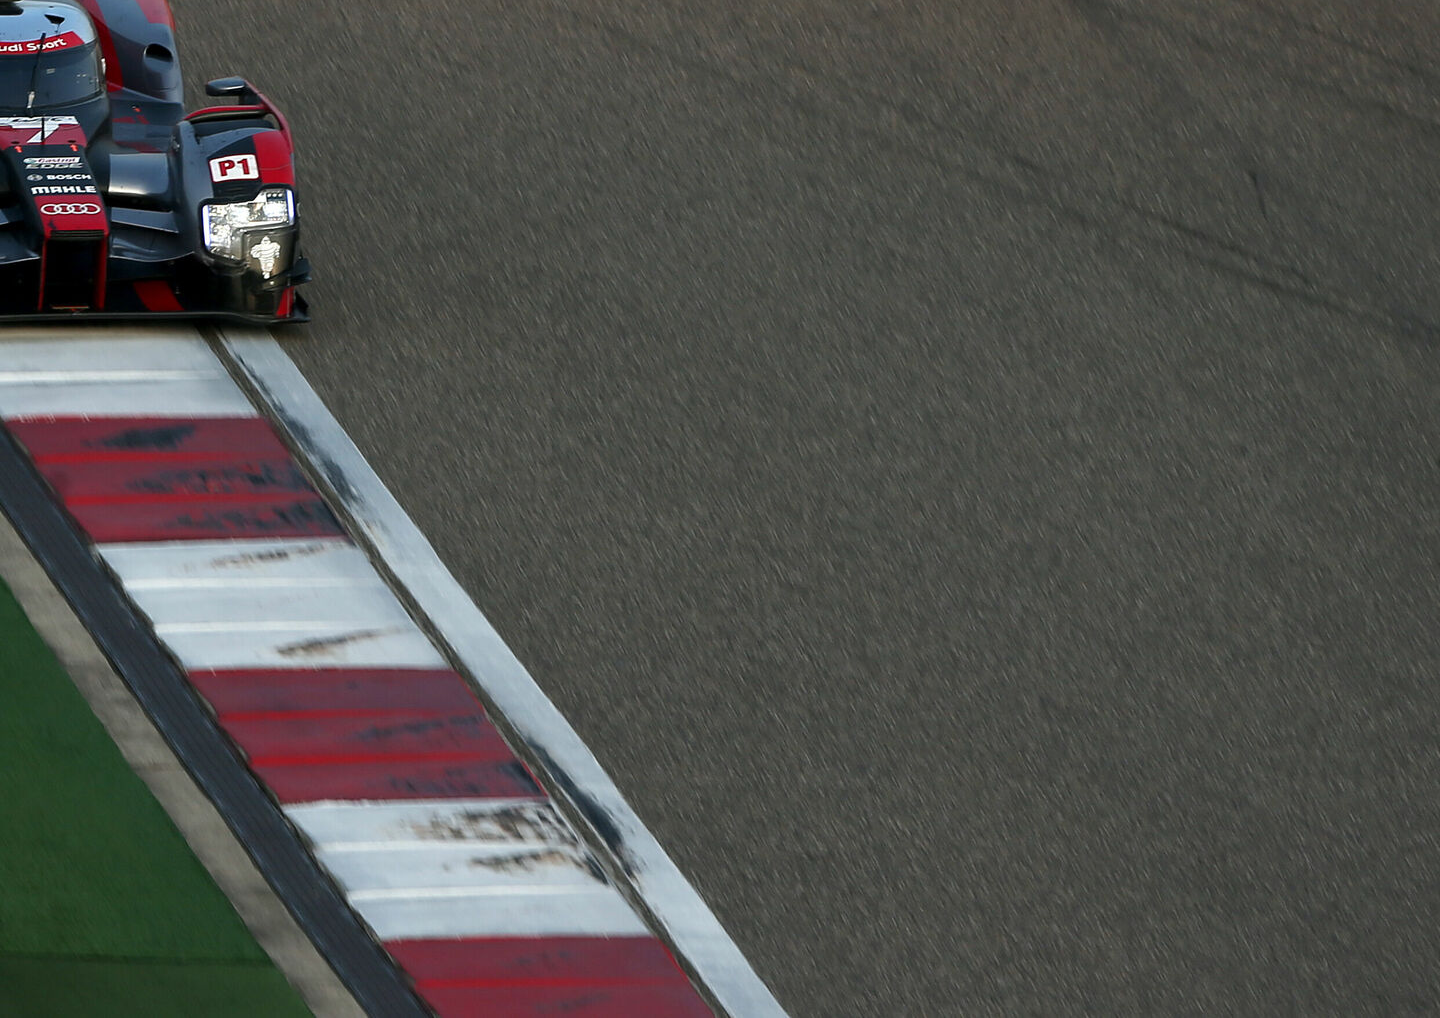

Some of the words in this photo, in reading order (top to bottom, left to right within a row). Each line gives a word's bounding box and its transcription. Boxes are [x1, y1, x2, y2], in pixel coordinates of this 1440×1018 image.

[26, 38, 68, 52] Sport
[25, 162, 83, 170] EDGE
[218, 158, 250, 177] P1
[30, 185, 97, 195] MAHLE
